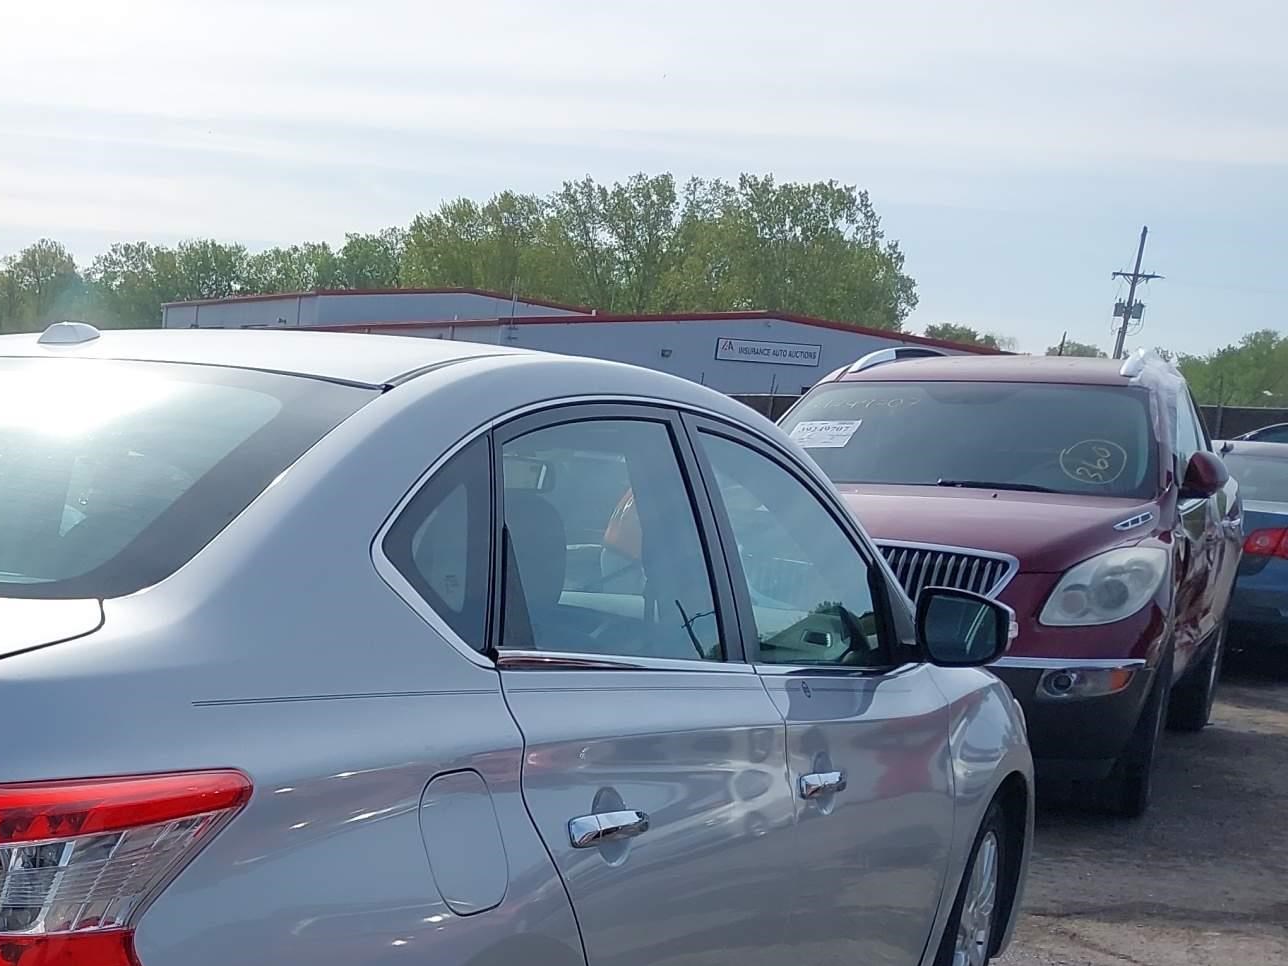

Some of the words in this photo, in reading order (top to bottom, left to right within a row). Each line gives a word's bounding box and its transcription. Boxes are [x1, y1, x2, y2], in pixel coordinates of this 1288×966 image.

[738, 346, 772, 357] INSURANCE
[772, 349, 787, 358] AUTO
[788, 350, 817, 360] AUCTIONS
